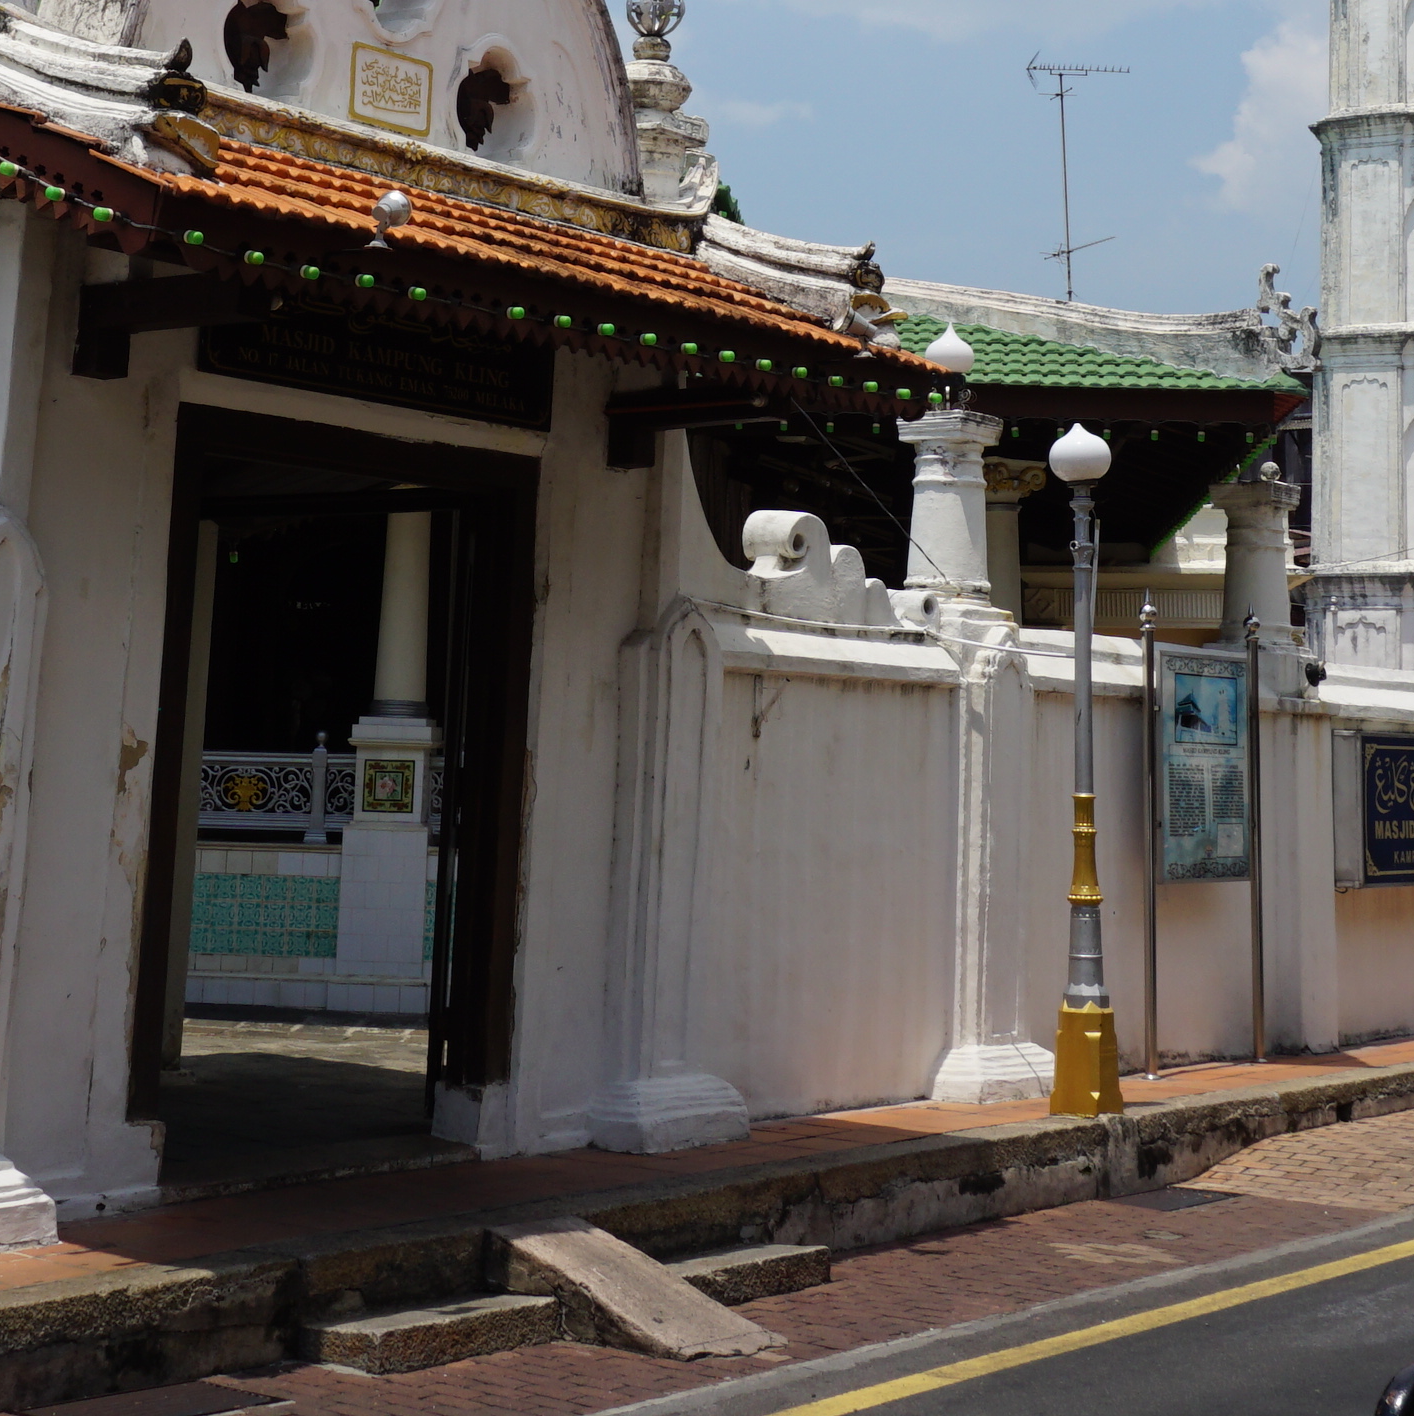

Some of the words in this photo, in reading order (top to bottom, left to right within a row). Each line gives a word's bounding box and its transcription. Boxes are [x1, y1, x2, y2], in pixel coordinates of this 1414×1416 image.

[237, 346, 261, 363] NO.
[268, 352, 279, 366] 17
[285, 355, 330, 376] JALAN
[337, 364, 393, 388] TUKANG
[442, 384, 470, 401] 75200
[475, 391, 526, 412] MELAKA
[260, 324, 336, 355] MASJID
[346, 340, 444, 376] KAMPUNG
[454, 361, 511, 389] KLING
